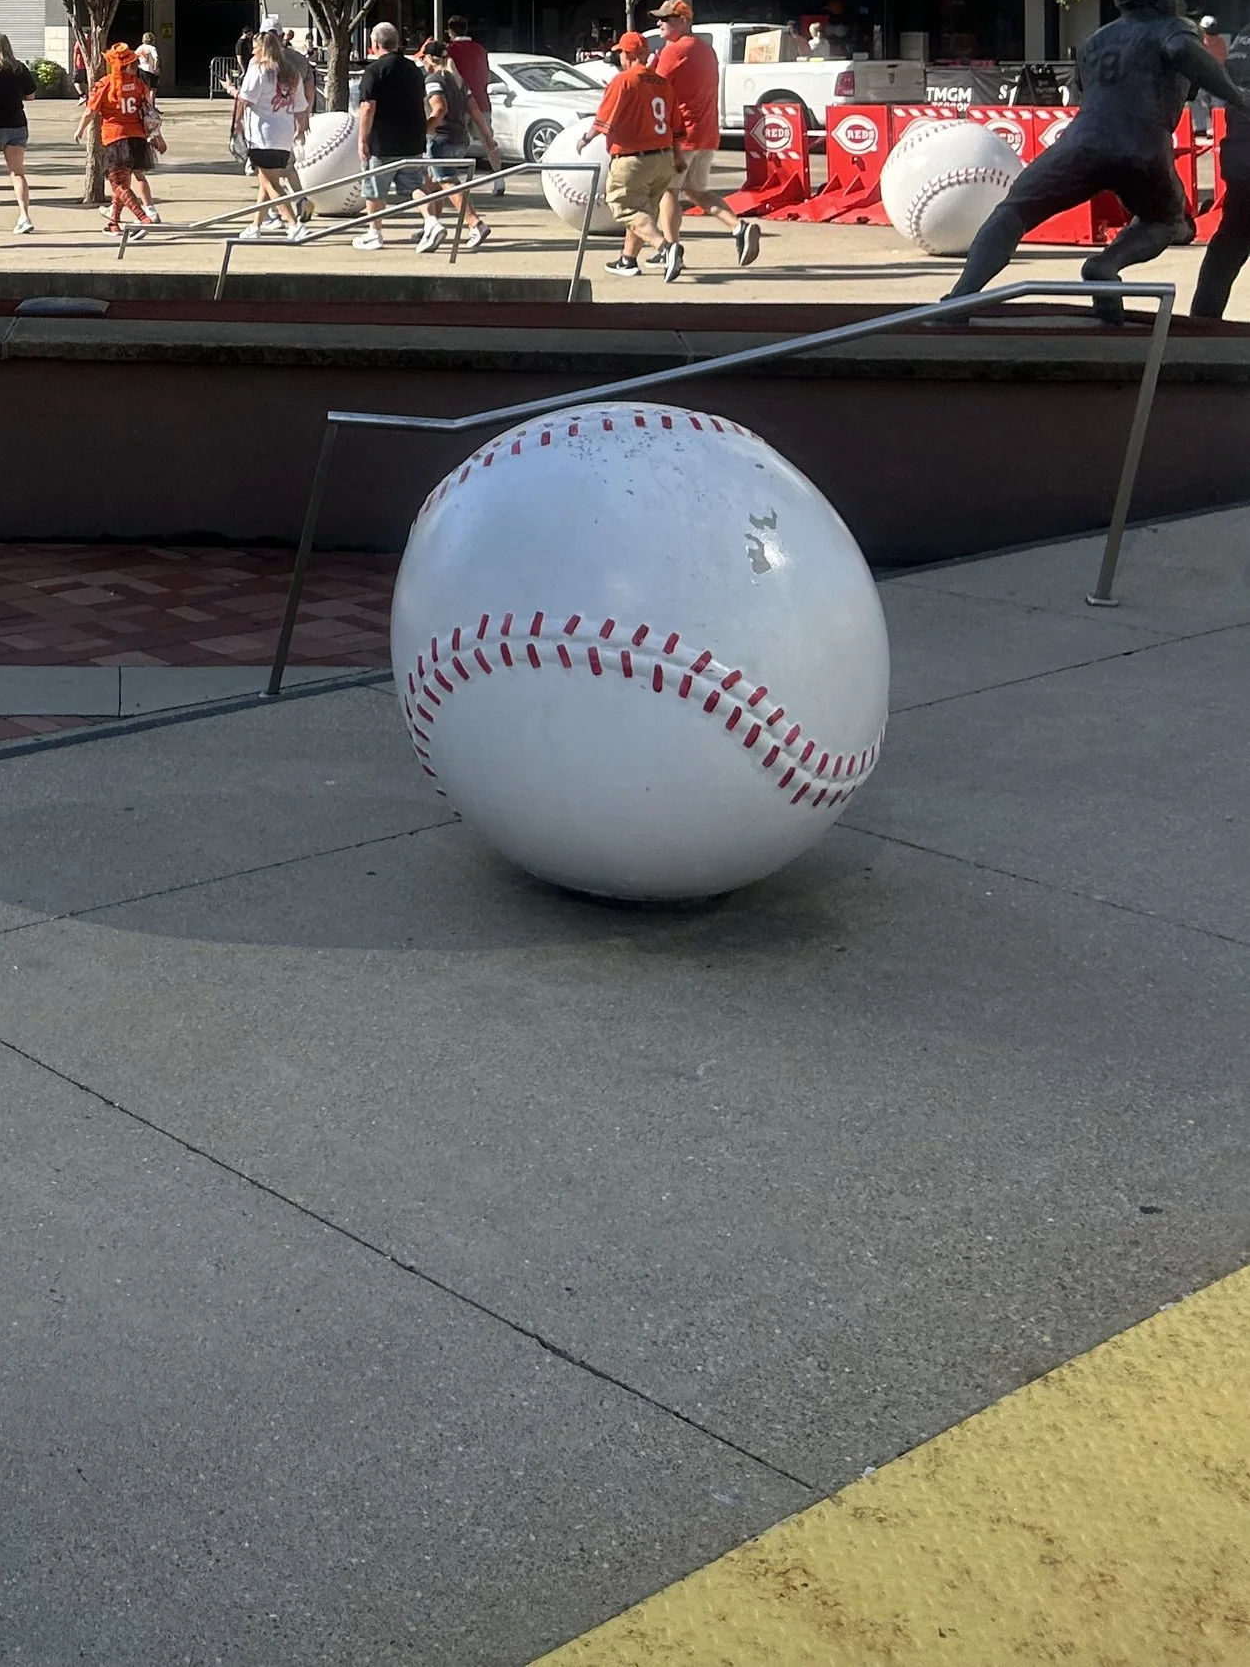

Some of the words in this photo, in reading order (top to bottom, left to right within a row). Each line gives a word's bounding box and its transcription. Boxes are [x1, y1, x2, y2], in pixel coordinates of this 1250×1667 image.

[120, 96, 138, 114] 16
[651, 96, 667, 135] 9
[764, 127, 791, 140] REDS
[845, 128, 875, 141] REDS
